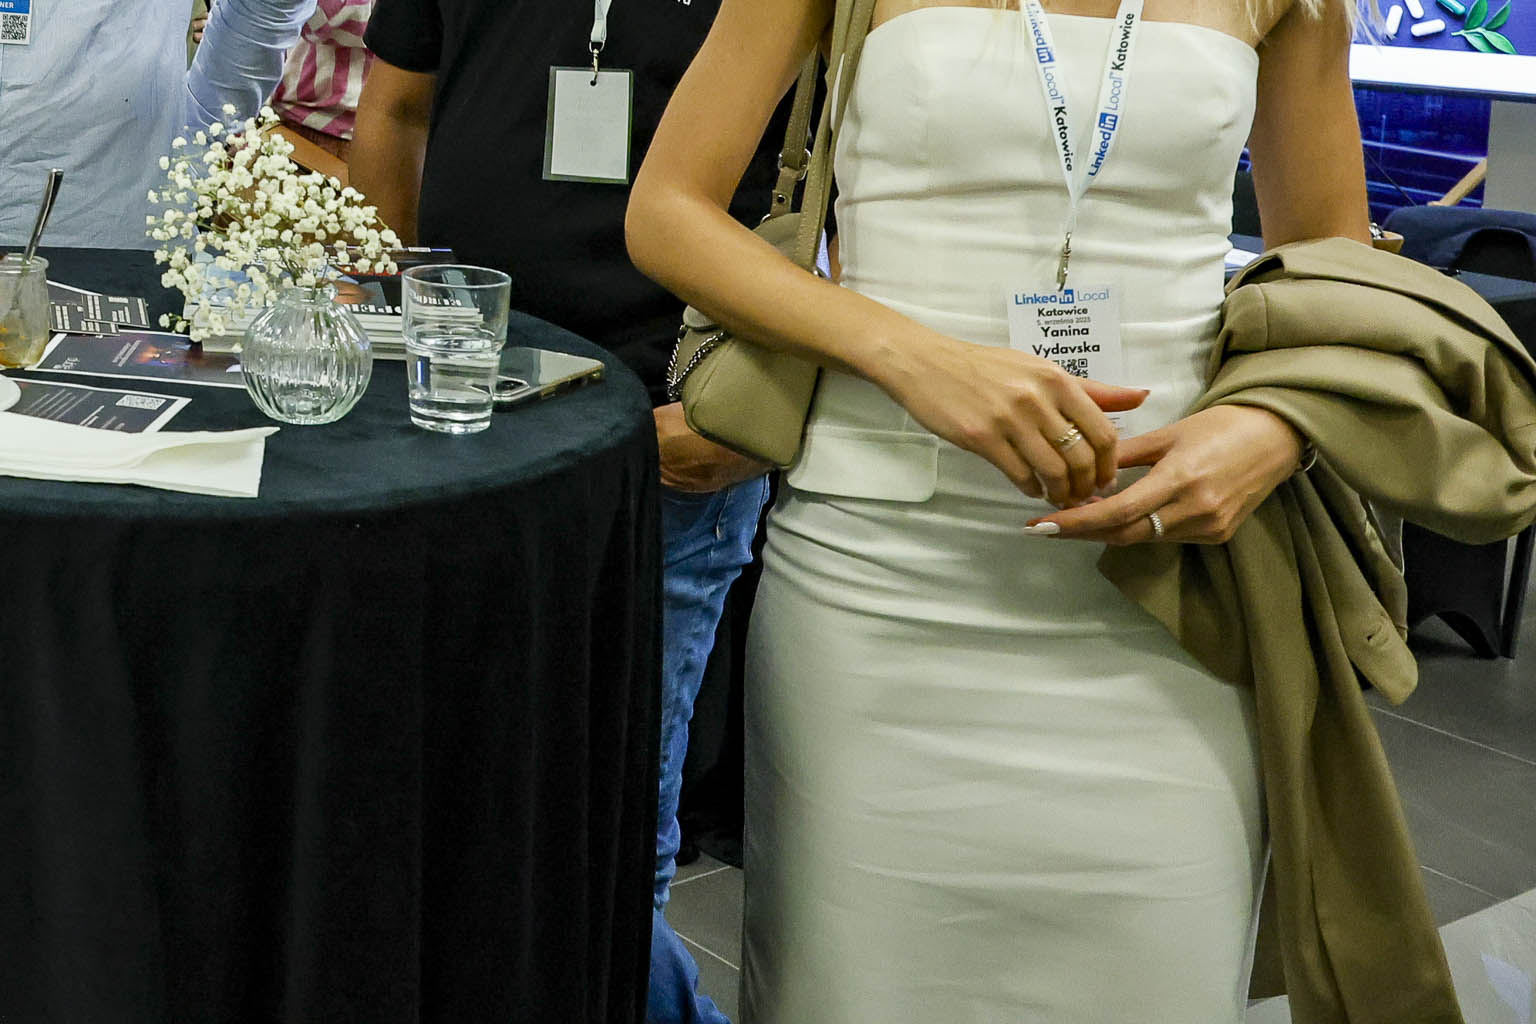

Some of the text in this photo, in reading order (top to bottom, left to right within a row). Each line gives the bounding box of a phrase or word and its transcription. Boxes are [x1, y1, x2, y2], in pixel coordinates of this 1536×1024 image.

[1112, 13, 1135, 71] Katowice
[1054, 105, 1074, 172] Katowice
[1077, 288, 1110, 302] Local
[1037, 305, 1089, 317] Katowice
[1041, 325, 1090, 338] Yanina
[1031, 341, 1101, 359] Vydavska
